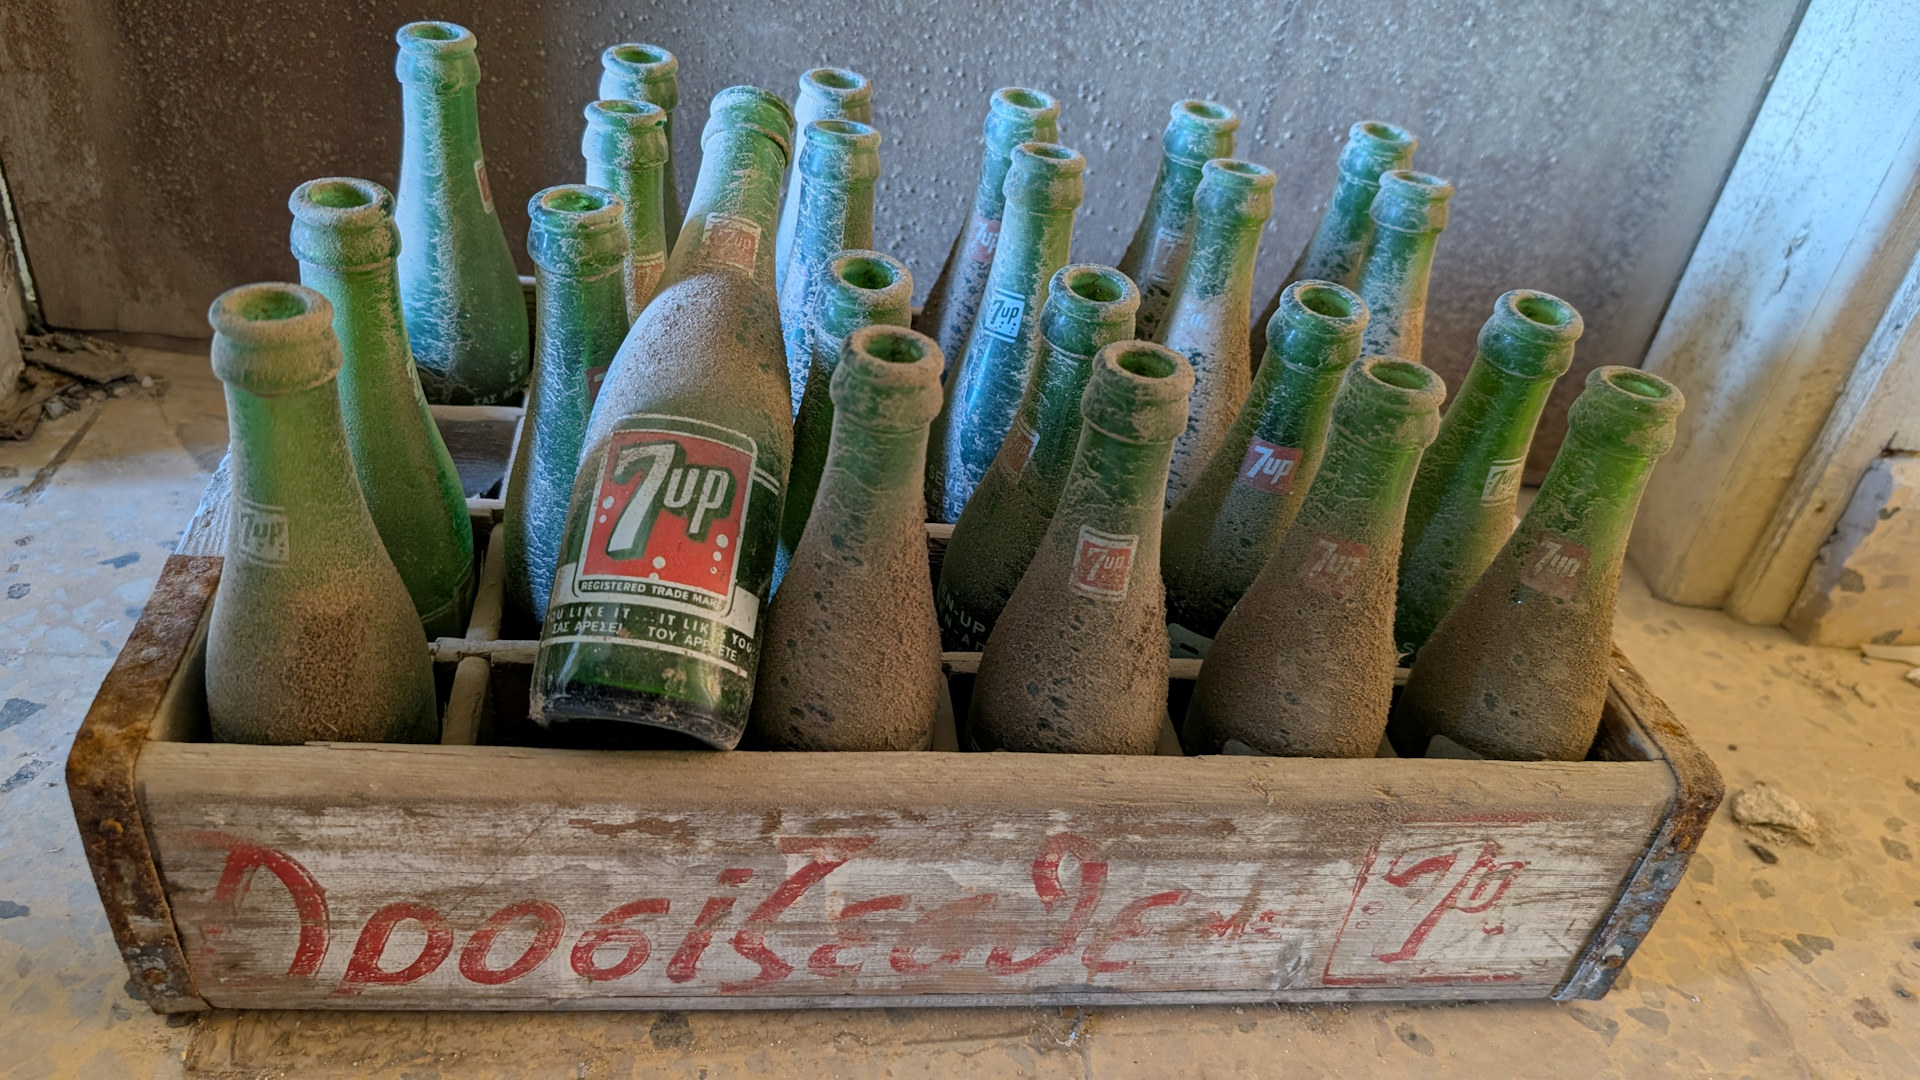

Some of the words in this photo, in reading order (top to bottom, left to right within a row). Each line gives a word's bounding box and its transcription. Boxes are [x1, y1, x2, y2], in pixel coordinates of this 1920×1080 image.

[989, 300, 1020, 326] 7up
[1246, 445, 1294, 484] 7up
[608, 443, 730, 553] 7up
[1087, 547, 1124, 582] 7up
[580, 580, 647, 593] REGISTERED
[651, 585, 689, 600] TRADE
[551, 621, 571, 635] ΣΑΣ
[648, 625, 678, 642] ΤΟΥ
[684, 634, 738, 662] ΑΡΕΕΤΕ
[569, 606, 605, 618] LIKE
[614, 607, 631, 619] IT
[659, 613, 677, 626] IT
[683, 618, 727, 641] LIKS
[732, 632, 753, 653] YOU
